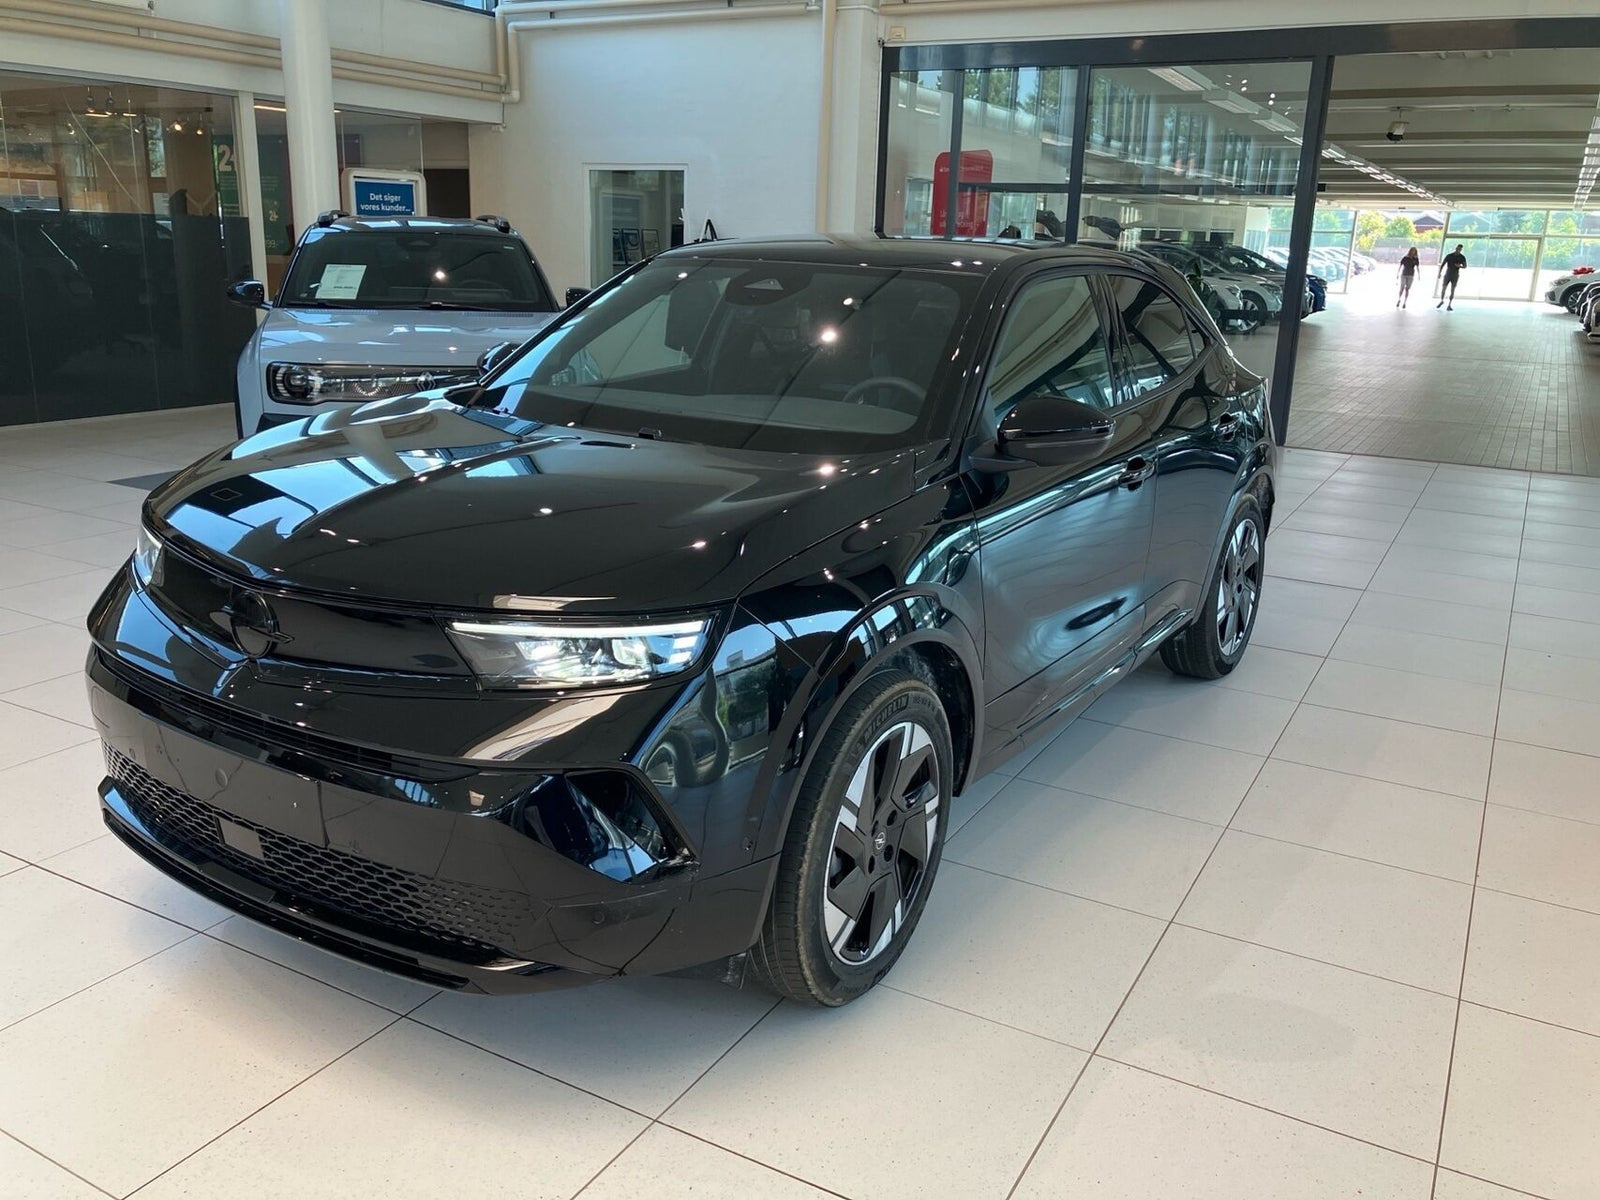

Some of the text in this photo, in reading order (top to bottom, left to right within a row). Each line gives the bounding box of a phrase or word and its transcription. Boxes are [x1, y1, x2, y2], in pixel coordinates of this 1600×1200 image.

[369, 192, 401, 204] Det siger
[360, 203, 380, 211] vores
[864, 694, 909, 743] MICHELIN
